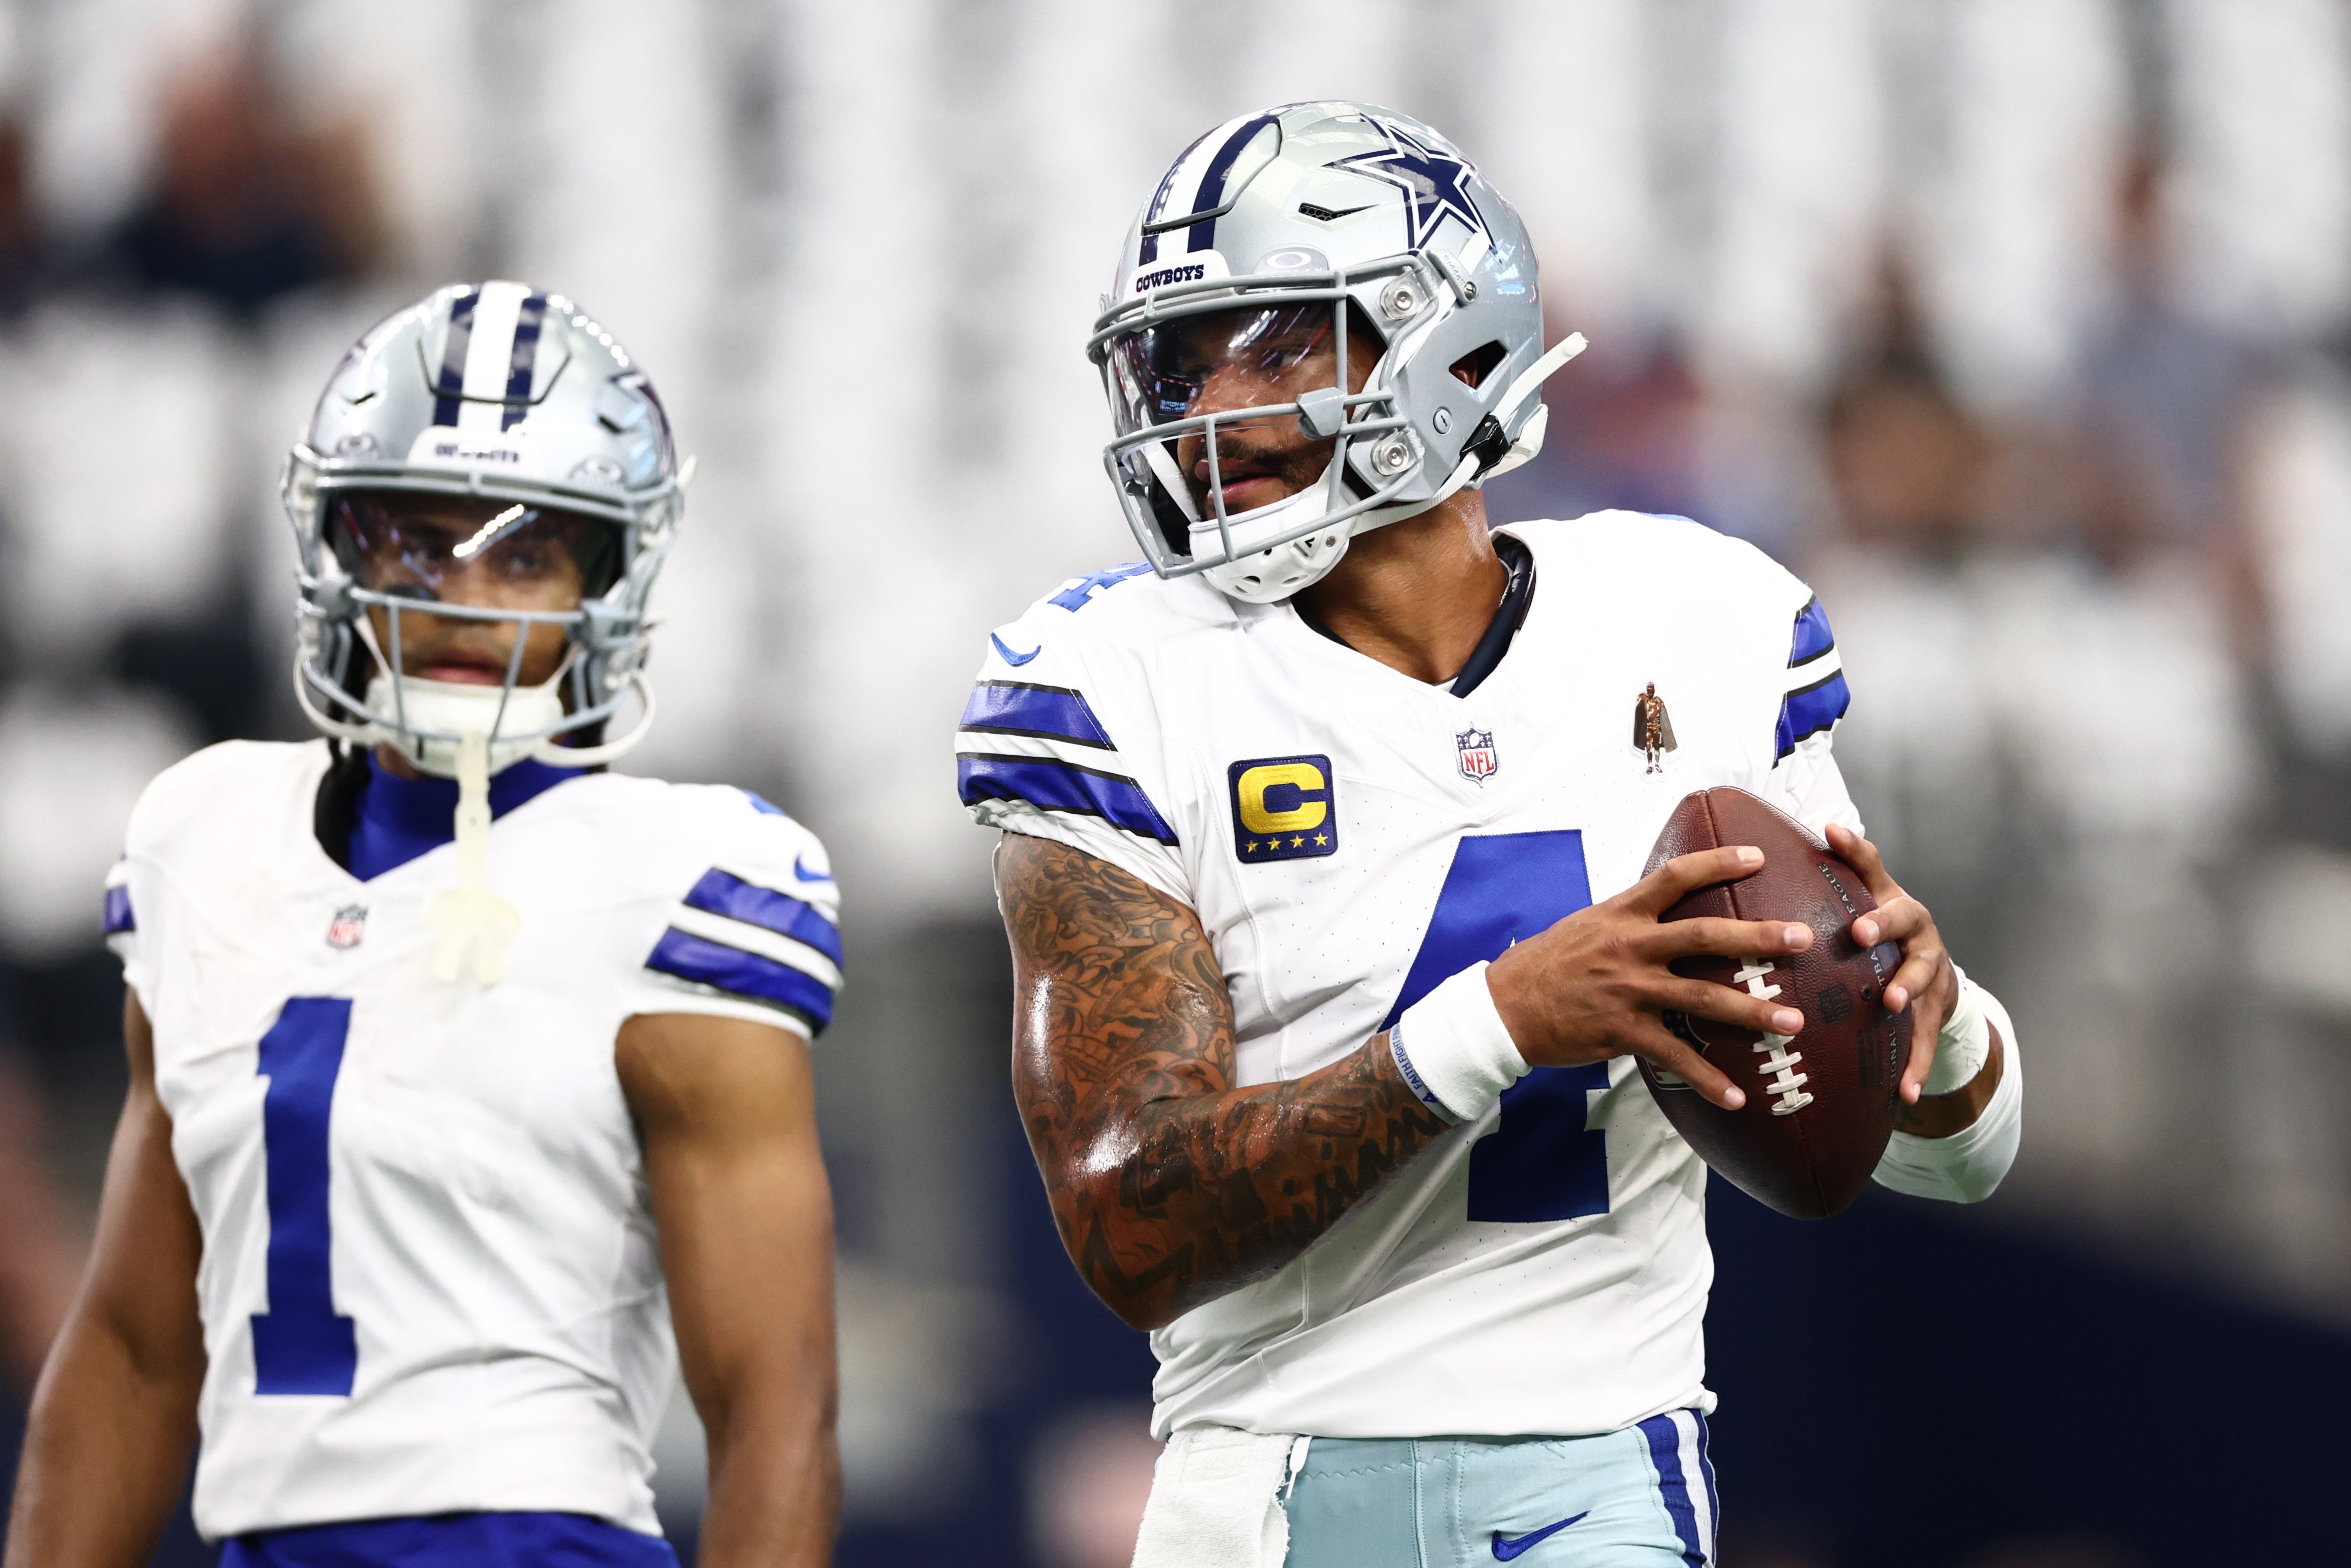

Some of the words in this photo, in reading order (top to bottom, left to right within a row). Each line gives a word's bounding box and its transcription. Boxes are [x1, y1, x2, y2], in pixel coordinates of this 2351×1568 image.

[1136, 264, 1204, 292] COWBOYS
[1463, 751, 1494, 775] NFL
[1237, 762, 1327, 834] C
[1819, 863, 1860, 918] EAGUE
[1377, 829, 1611, 1222] 4
[1393, 1040, 1407, 1063] FIGHT
[1402, 1063, 1423, 1090] FAITH
[250, 995, 359, 1397] 1
